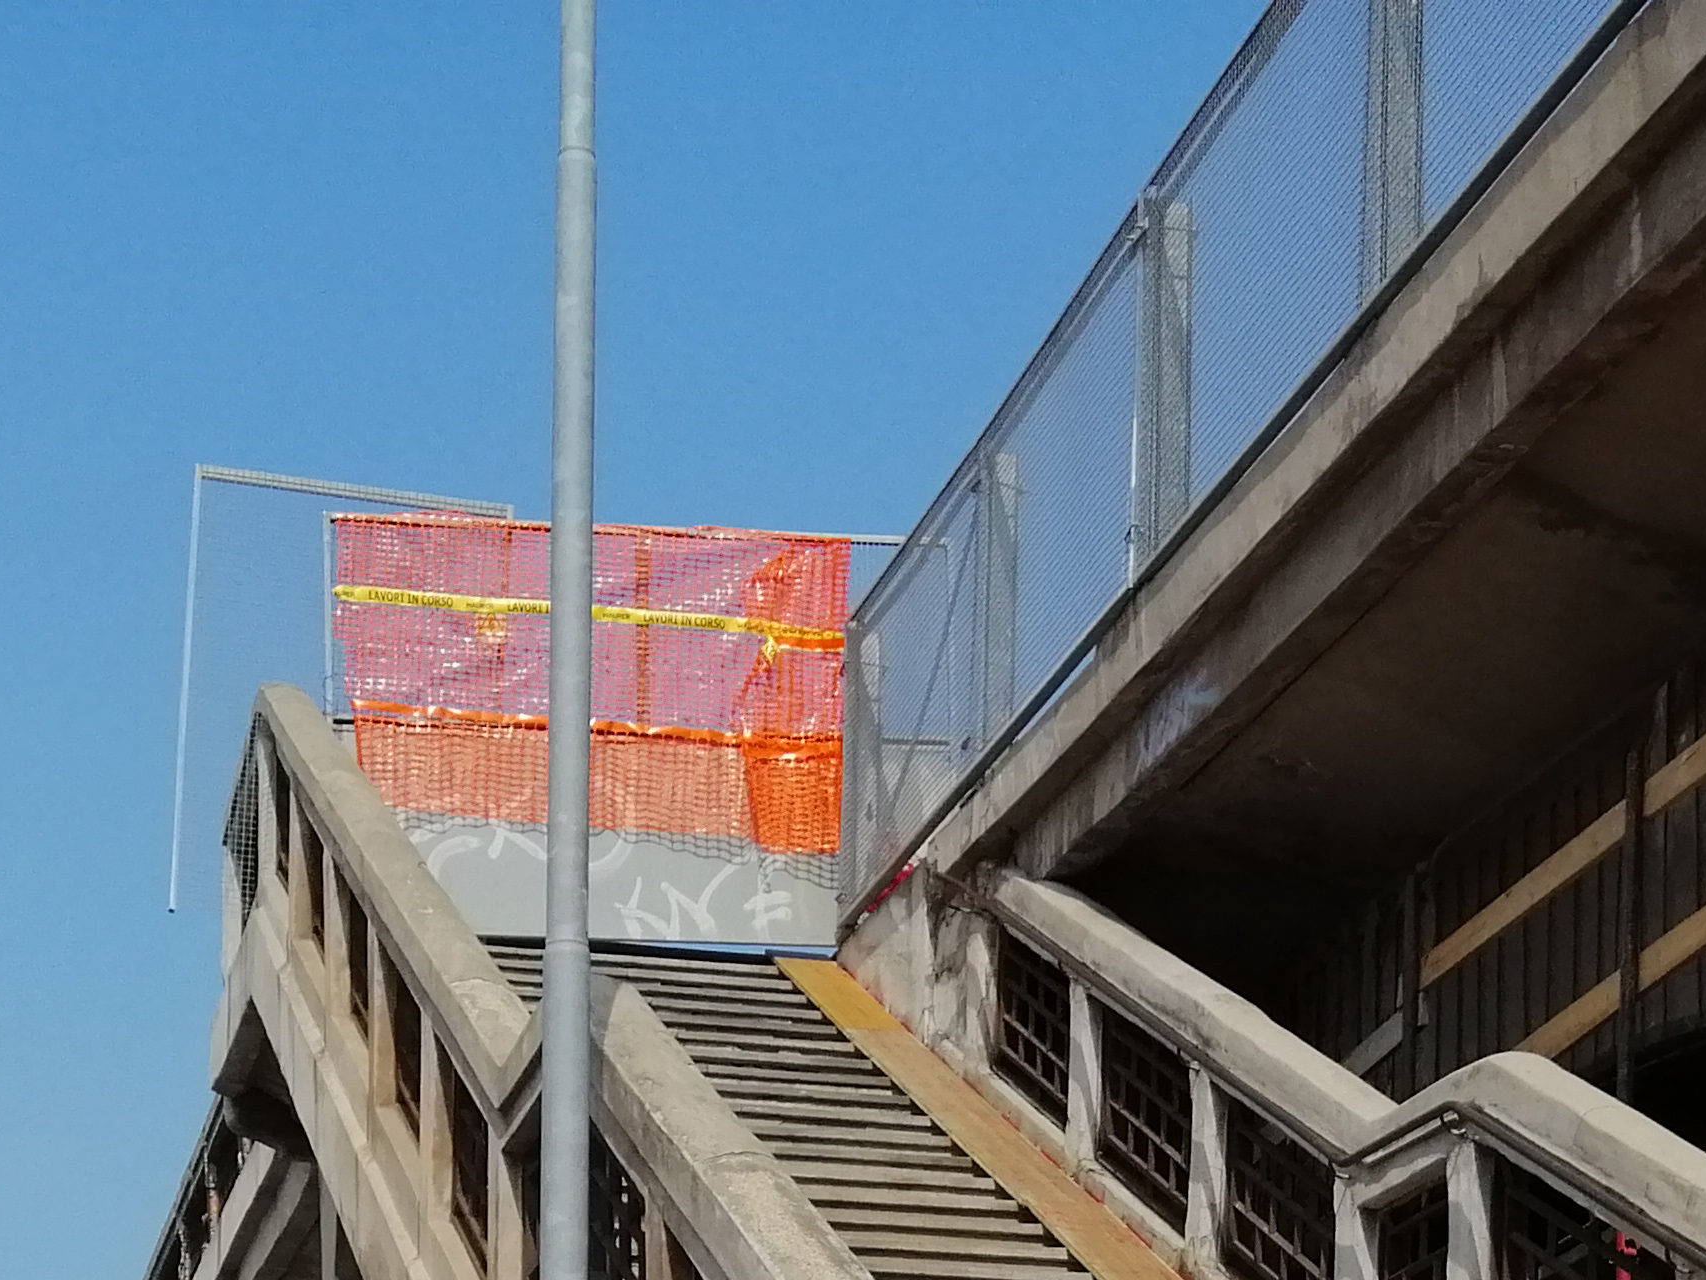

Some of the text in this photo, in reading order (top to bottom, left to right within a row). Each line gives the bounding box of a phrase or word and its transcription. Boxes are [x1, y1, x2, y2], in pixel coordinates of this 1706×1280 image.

[369, 591, 403, 604] LAVORI
[407, 593, 419, 604] IN
[421, 595, 454, 608] CORSO
[507, 602, 543, 613] LAVORI
[643, 613, 678, 624] LAVORI
[680, 615, 692, 626] IN
[694, 616, 725, 630] CORSO
